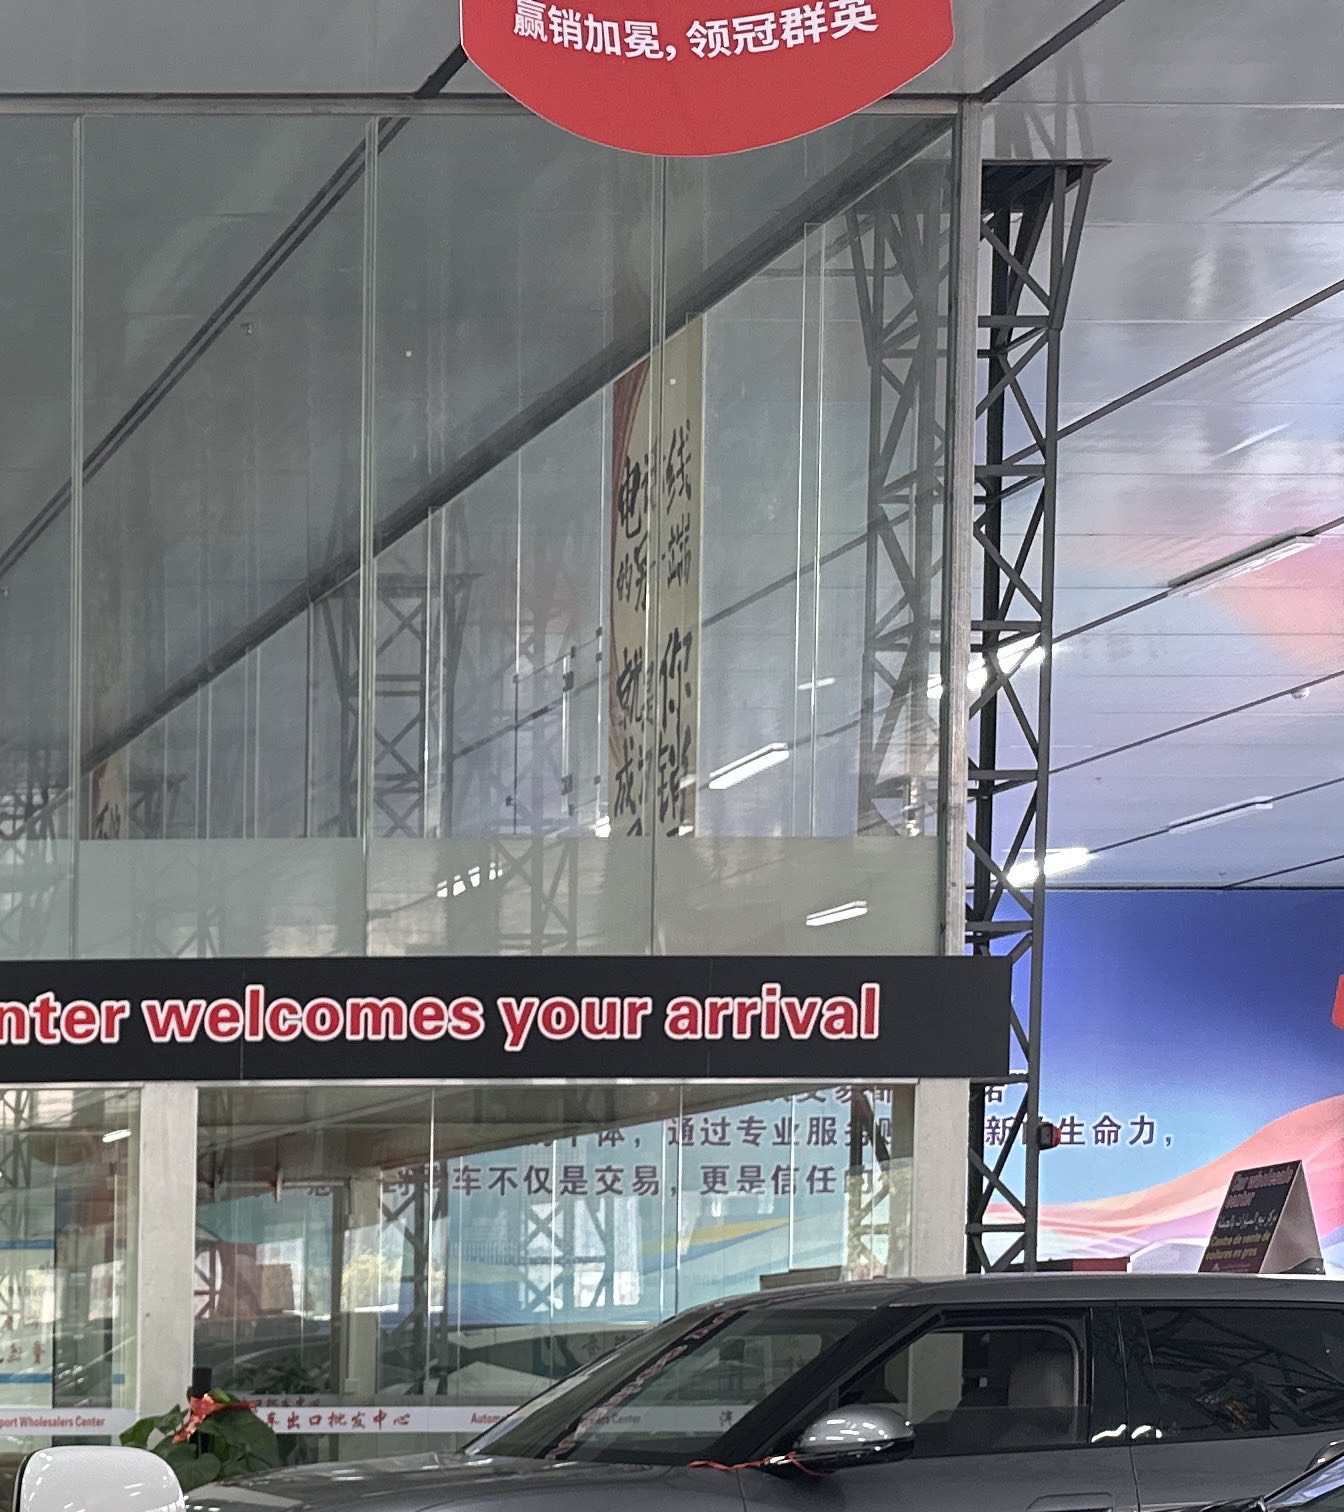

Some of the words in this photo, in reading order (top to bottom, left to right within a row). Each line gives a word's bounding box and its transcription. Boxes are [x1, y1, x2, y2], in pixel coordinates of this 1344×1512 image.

[141, 984, 486, 1043] welcomes
[496, 996, 653, 1052] your
[664, 982, 881, 1041] arrival
[985, 1114, 1175, 1147] 新生命力，
[75, 1414, 105, 1427] Center
[265, 1409, 412, 1430] 车出口批发中心
